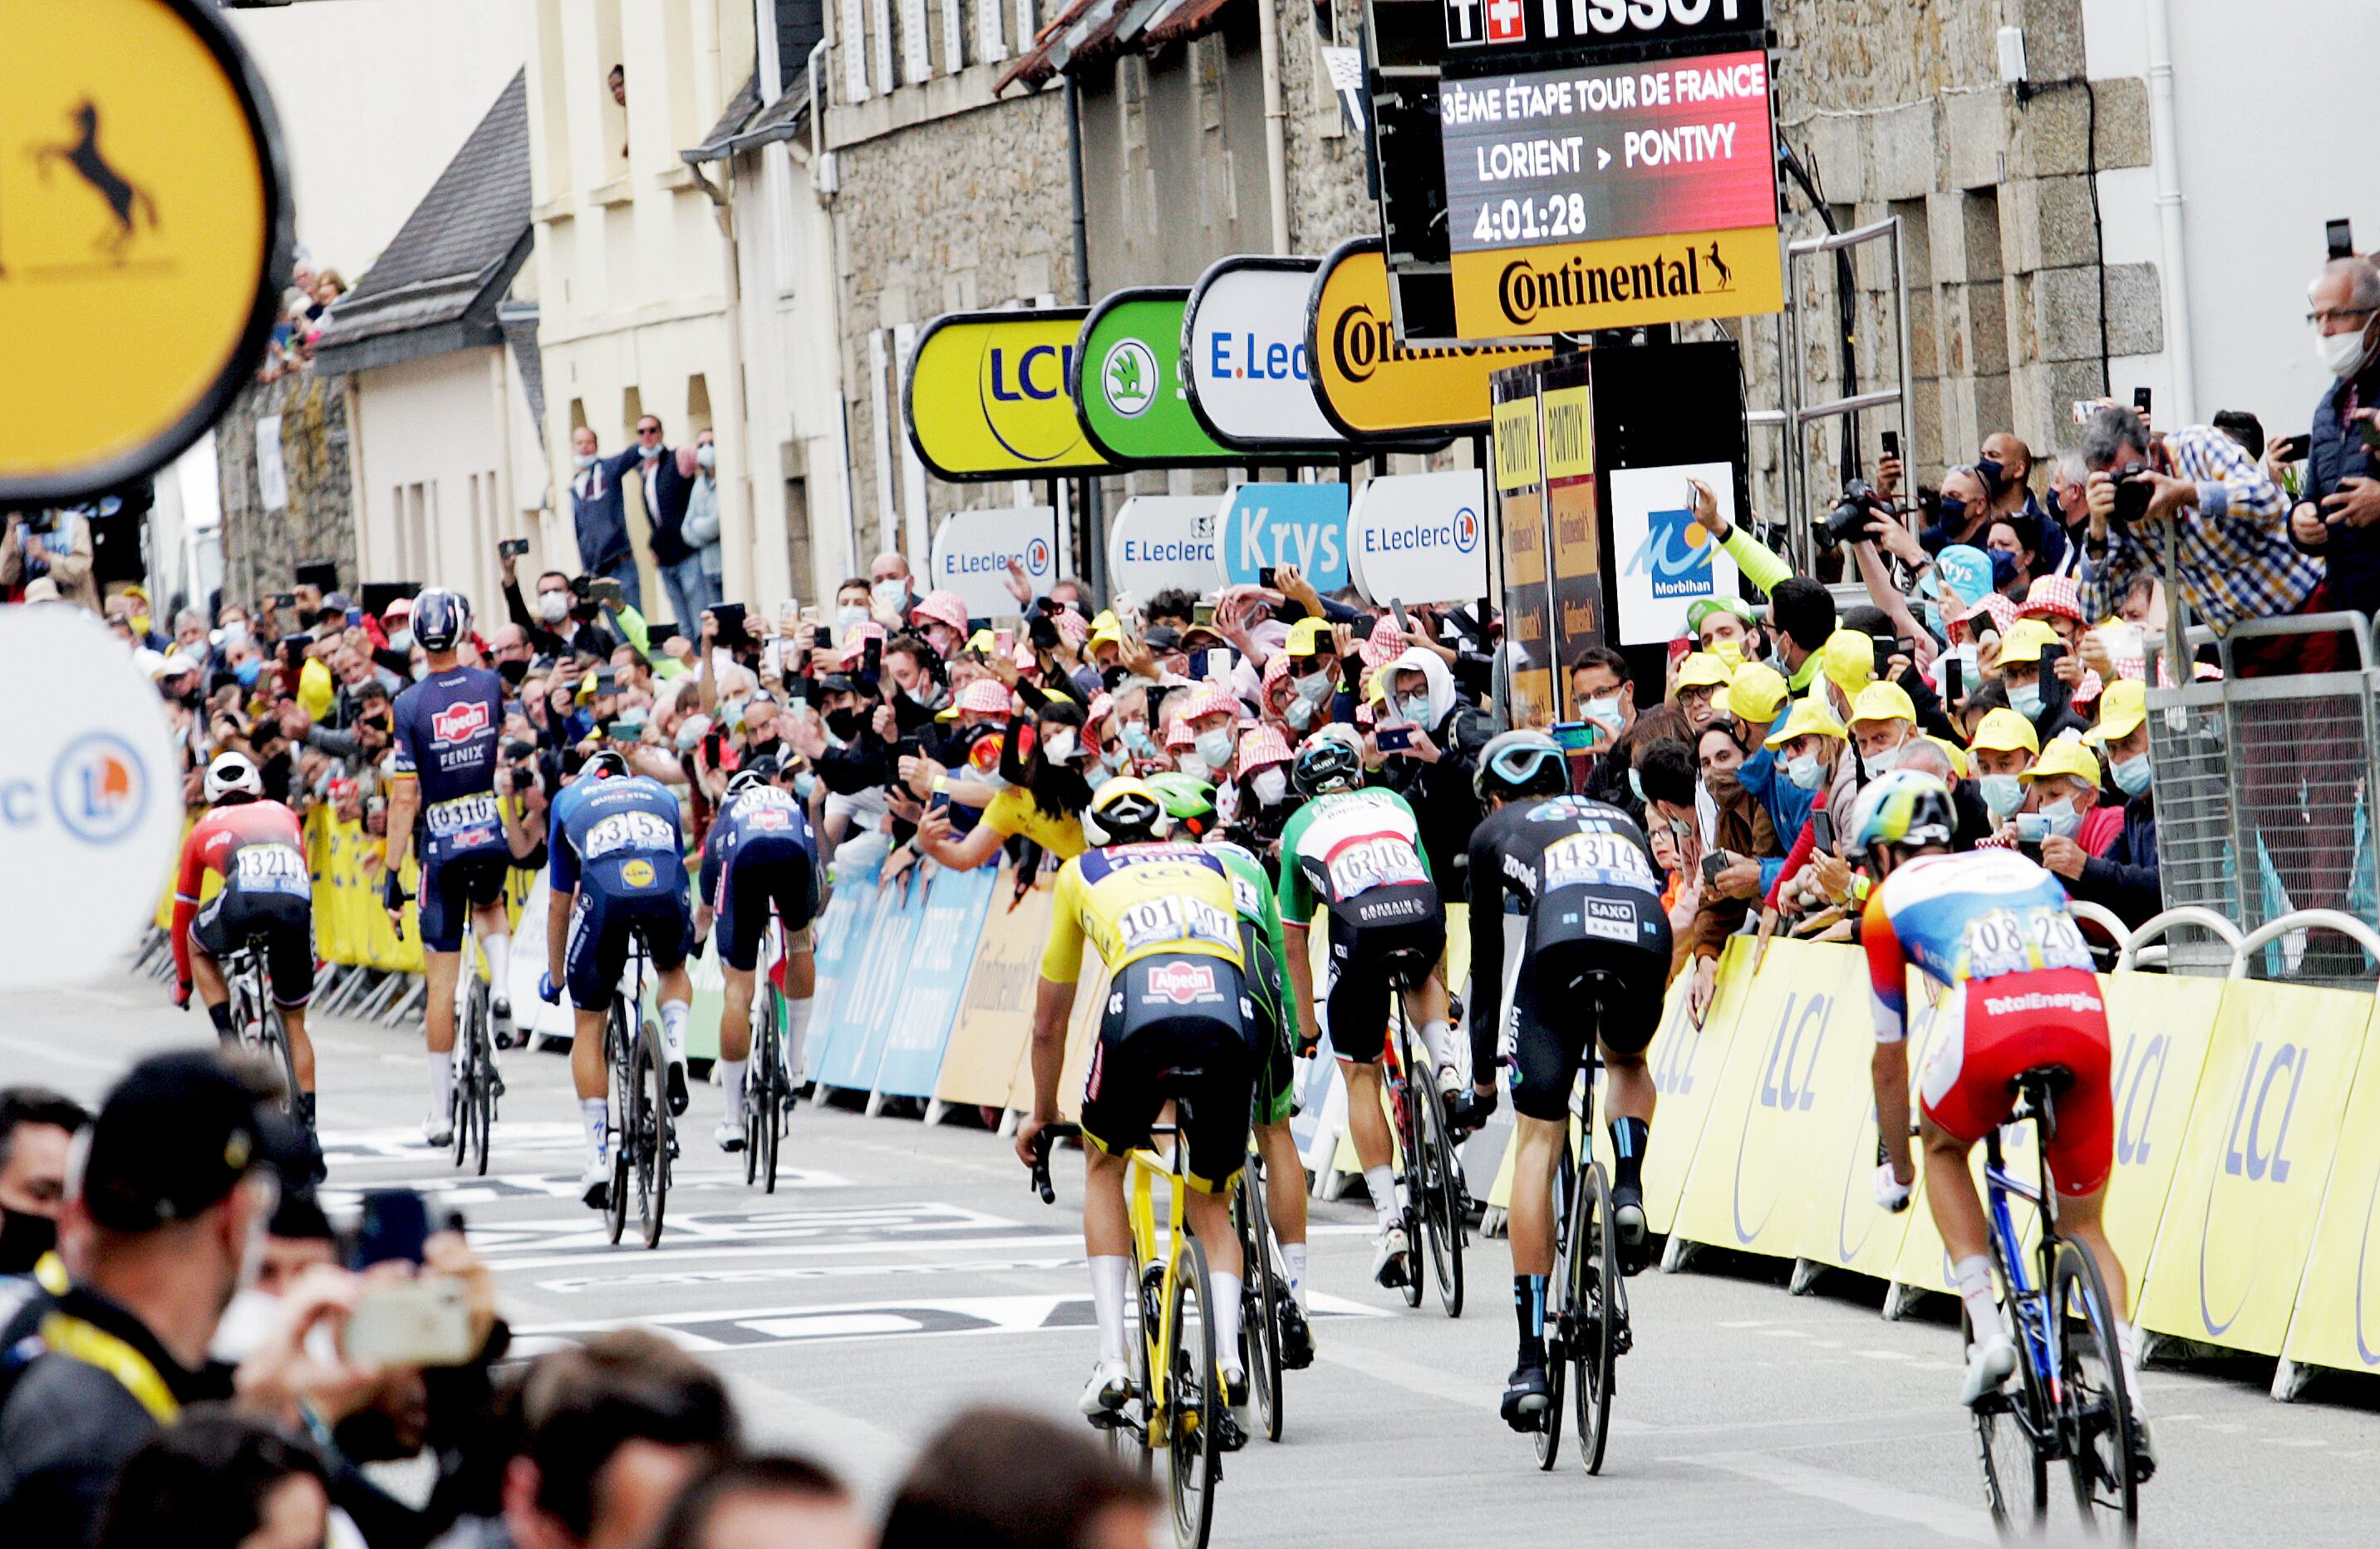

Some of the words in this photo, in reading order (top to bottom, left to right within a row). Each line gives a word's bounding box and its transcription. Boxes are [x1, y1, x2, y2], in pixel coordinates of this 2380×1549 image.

[1442, 82, 1502, 125] 3ÈME
[1506, 79, 1573, 119] ÉTAPE
[1576, 75, 1636, 111] TOUR
[1641, 71, 1670, 105] DE
[1675, 63, 1766, 102] FRANCE
[1477, 136, 1584, 181] LORIENT
[1624, 122, 1737, 168] PONTIVY
[1473, 193, 1586, 243] 4:01:28
[1498, 246, 1702, 325] Continental
[1499, 415, 1532, 476] PONTIVY
[1548, 402, 1584, 465] PONTIVY
[1241, 507, 1340, 581] Krys
[1365, 524, 1450, 553] E.Leclerc
[1655, 579, 1711, 595] Morbihan
[440, 744, 485, 766] FENIX
[1552, 839, 1600, 871] 143
[1124, 899, 1175, 939] 101
[1590, 902, 1631, 920] SAXO
[1593, 922, 1630, 937] BANK
[1155, 971, 1209, 993] Alpecin
[1984, 991, 2102, 1015] TotalEnergies
[1508, 1006, 1522, 1055] DSM
[1761, 992, 1835, 1112] LCL
[2225, 1041, 2309, 1183] LCL
